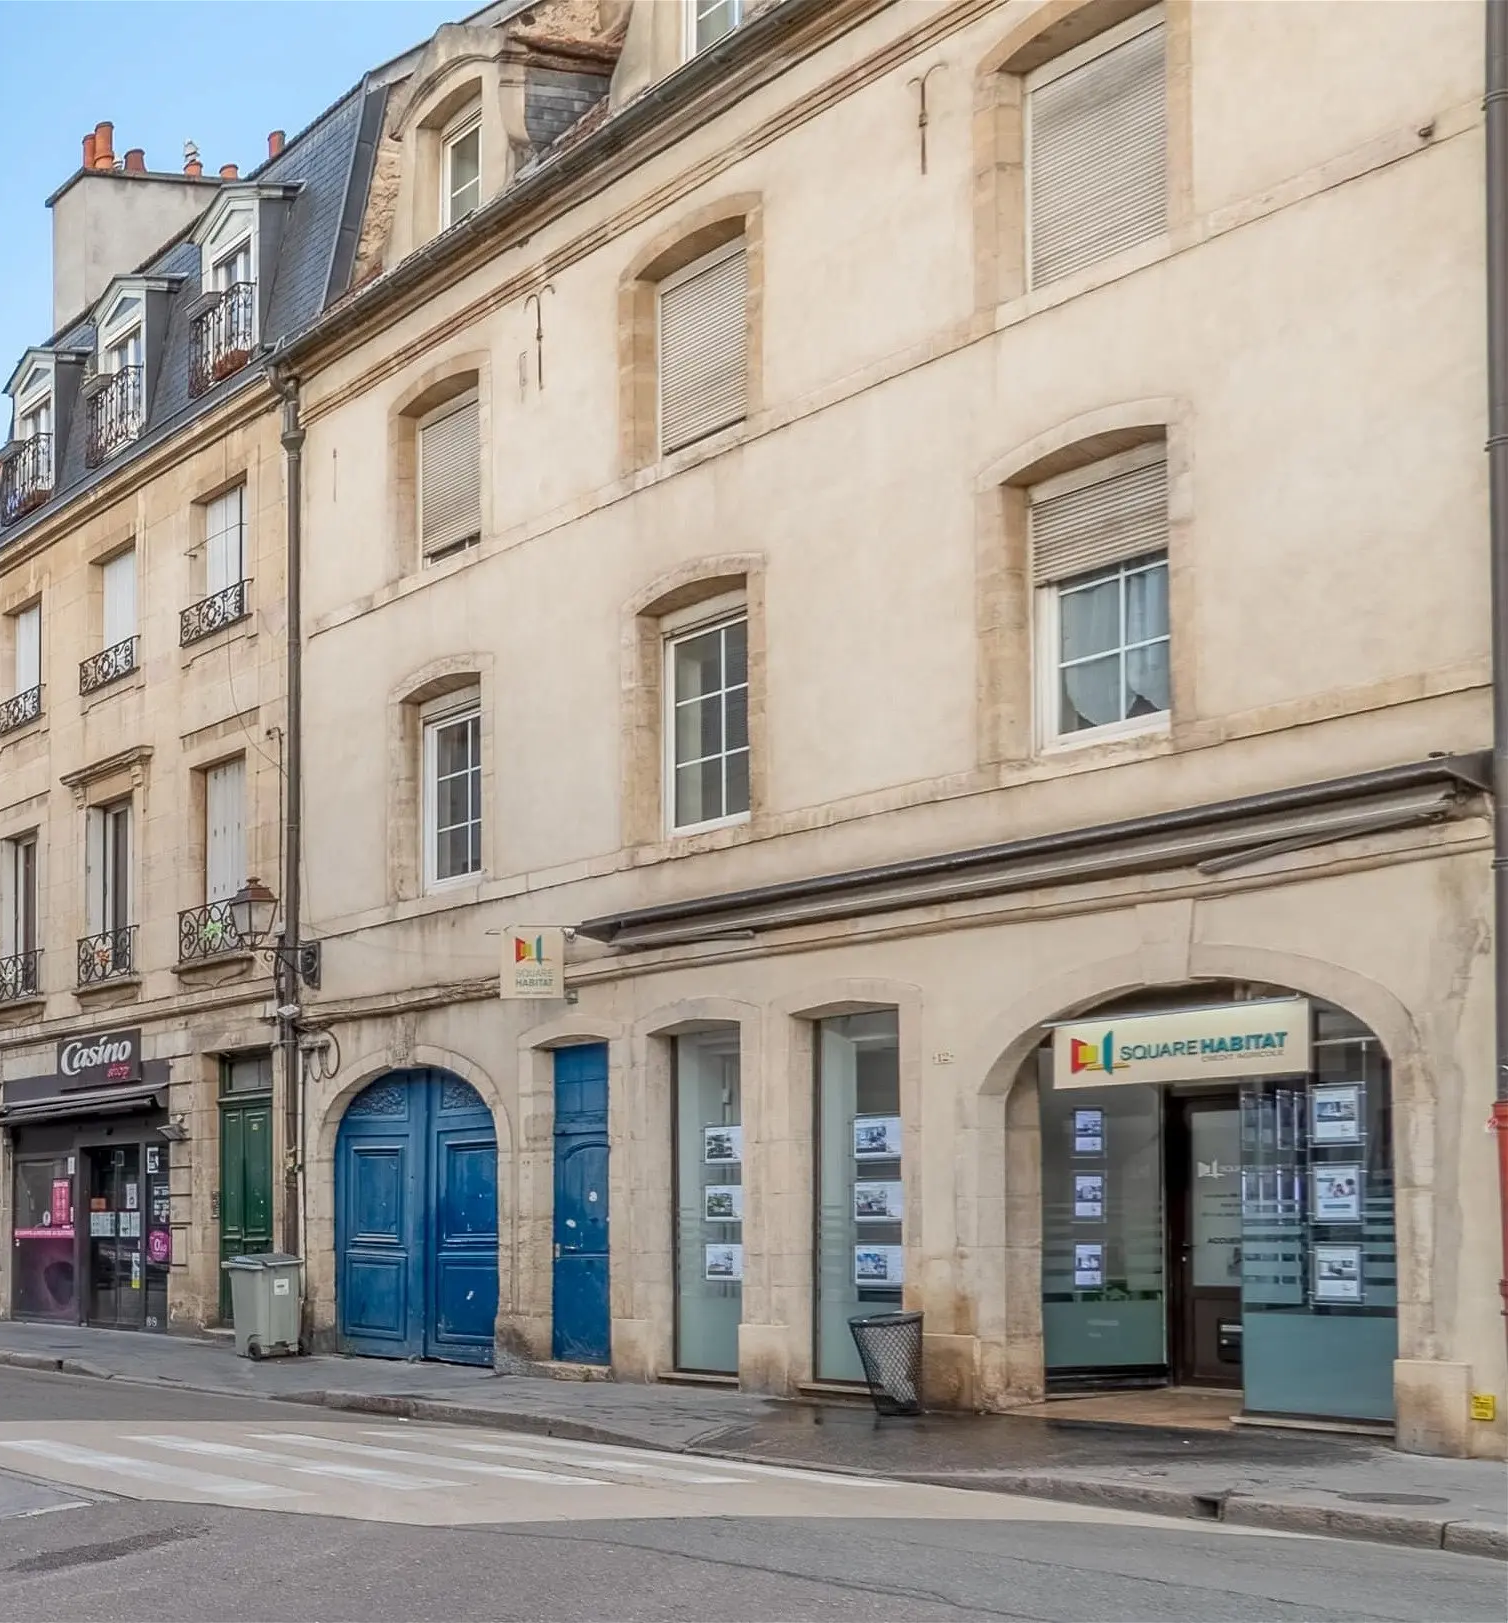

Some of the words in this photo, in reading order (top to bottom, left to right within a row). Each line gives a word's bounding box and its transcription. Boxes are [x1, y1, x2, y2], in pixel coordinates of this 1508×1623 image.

[516, 978, 553, 987] HABITAT
[1119, 1039, 1198, 1061] SQUARE
[1200, 1031, 1288, 1054] HABITAT
[1236, 1050, 1285, 1059] AGRICOLE
[60, 1036, 132, 1076] Casino
